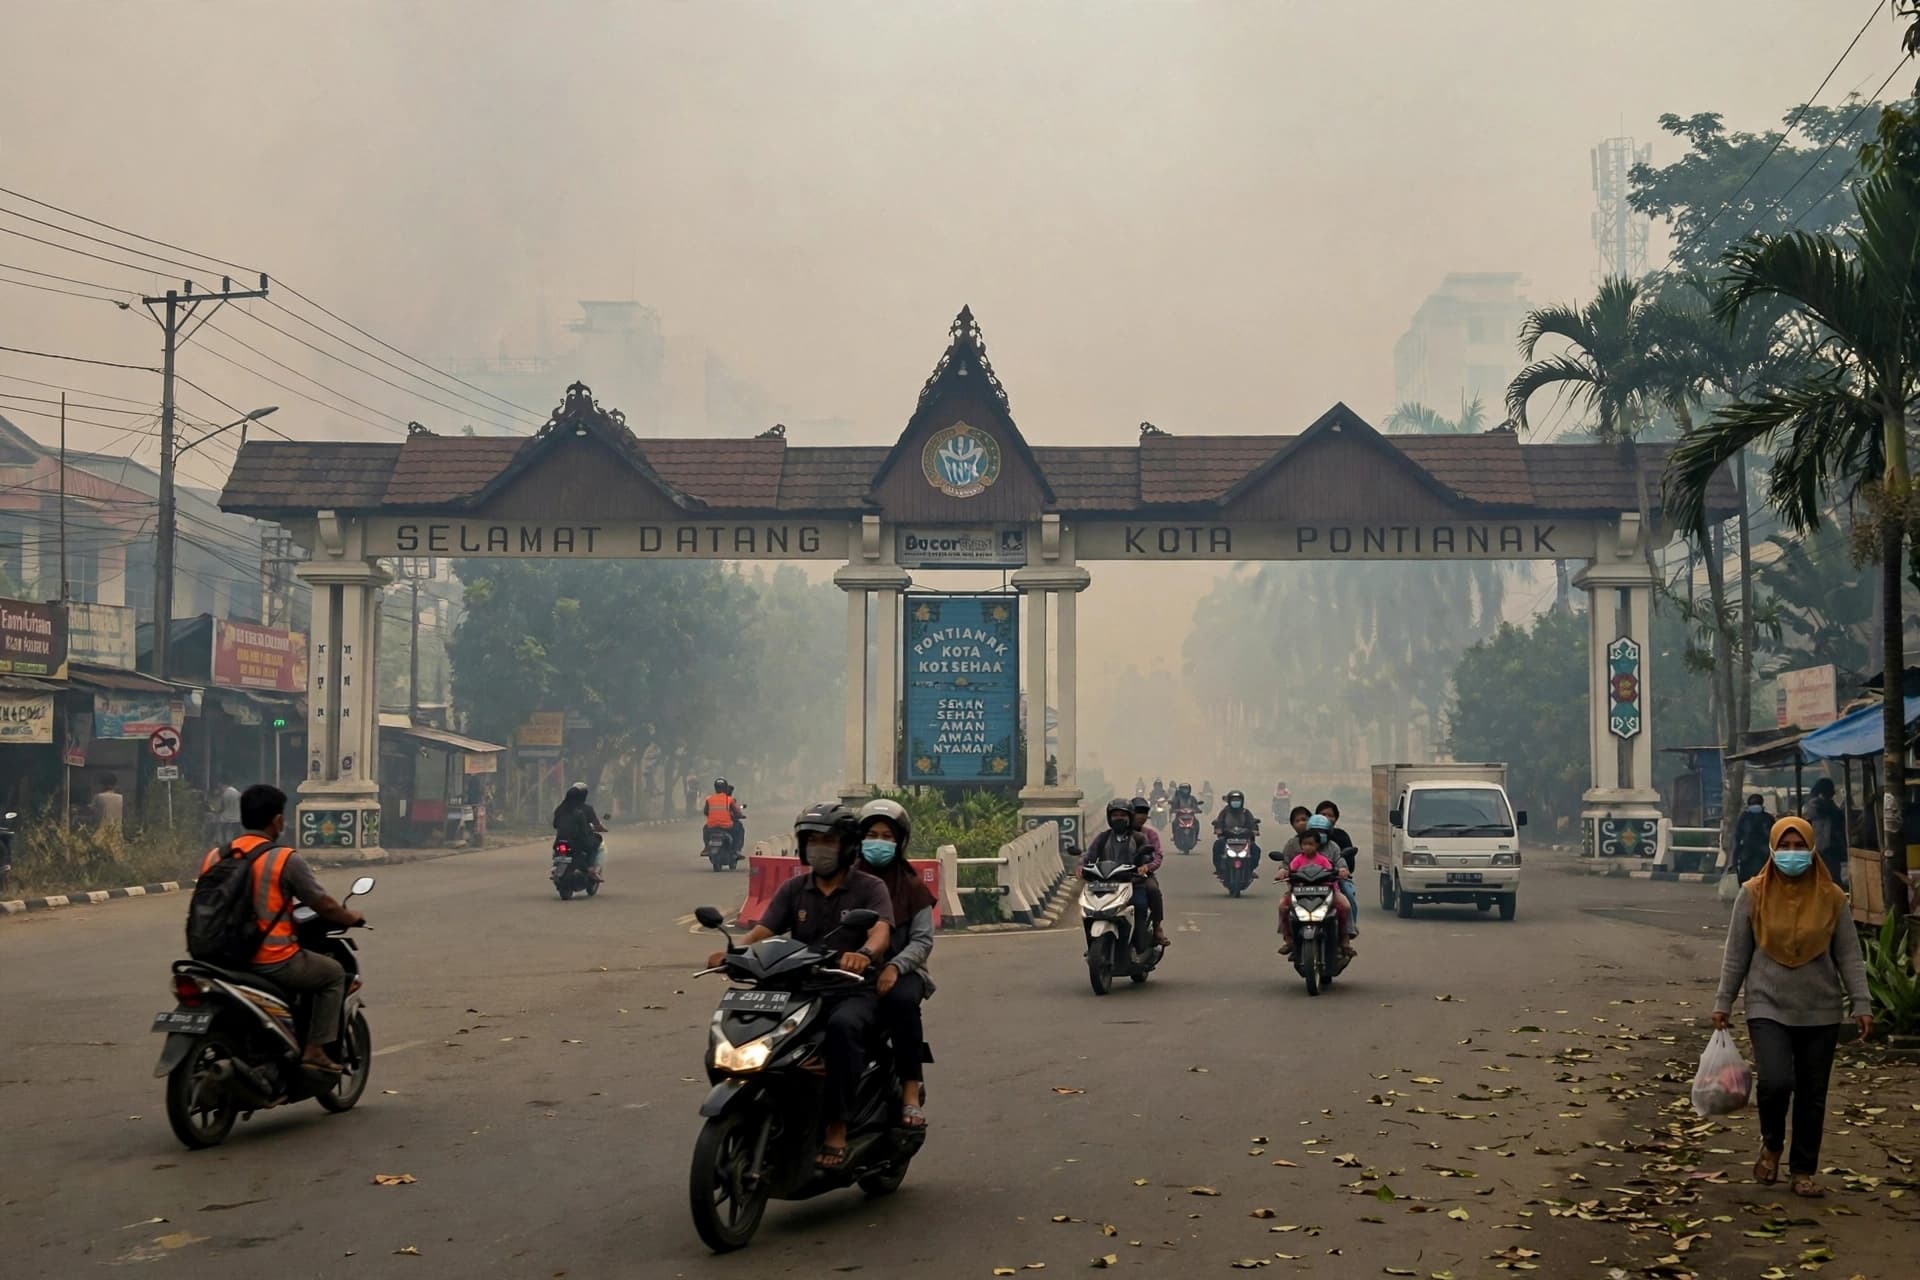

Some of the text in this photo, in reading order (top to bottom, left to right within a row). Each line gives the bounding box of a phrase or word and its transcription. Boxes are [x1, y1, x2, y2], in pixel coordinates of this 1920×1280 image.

[397, 525, 821, 553] SELAMAT DATANG
[1125, 525, 1556, 553] KOTA PONTIANAK
[942, 645, 981, 658] KOTA
[936, 710, 985, 720] SEHAT
[937, 732, 985, 743] AMAN
